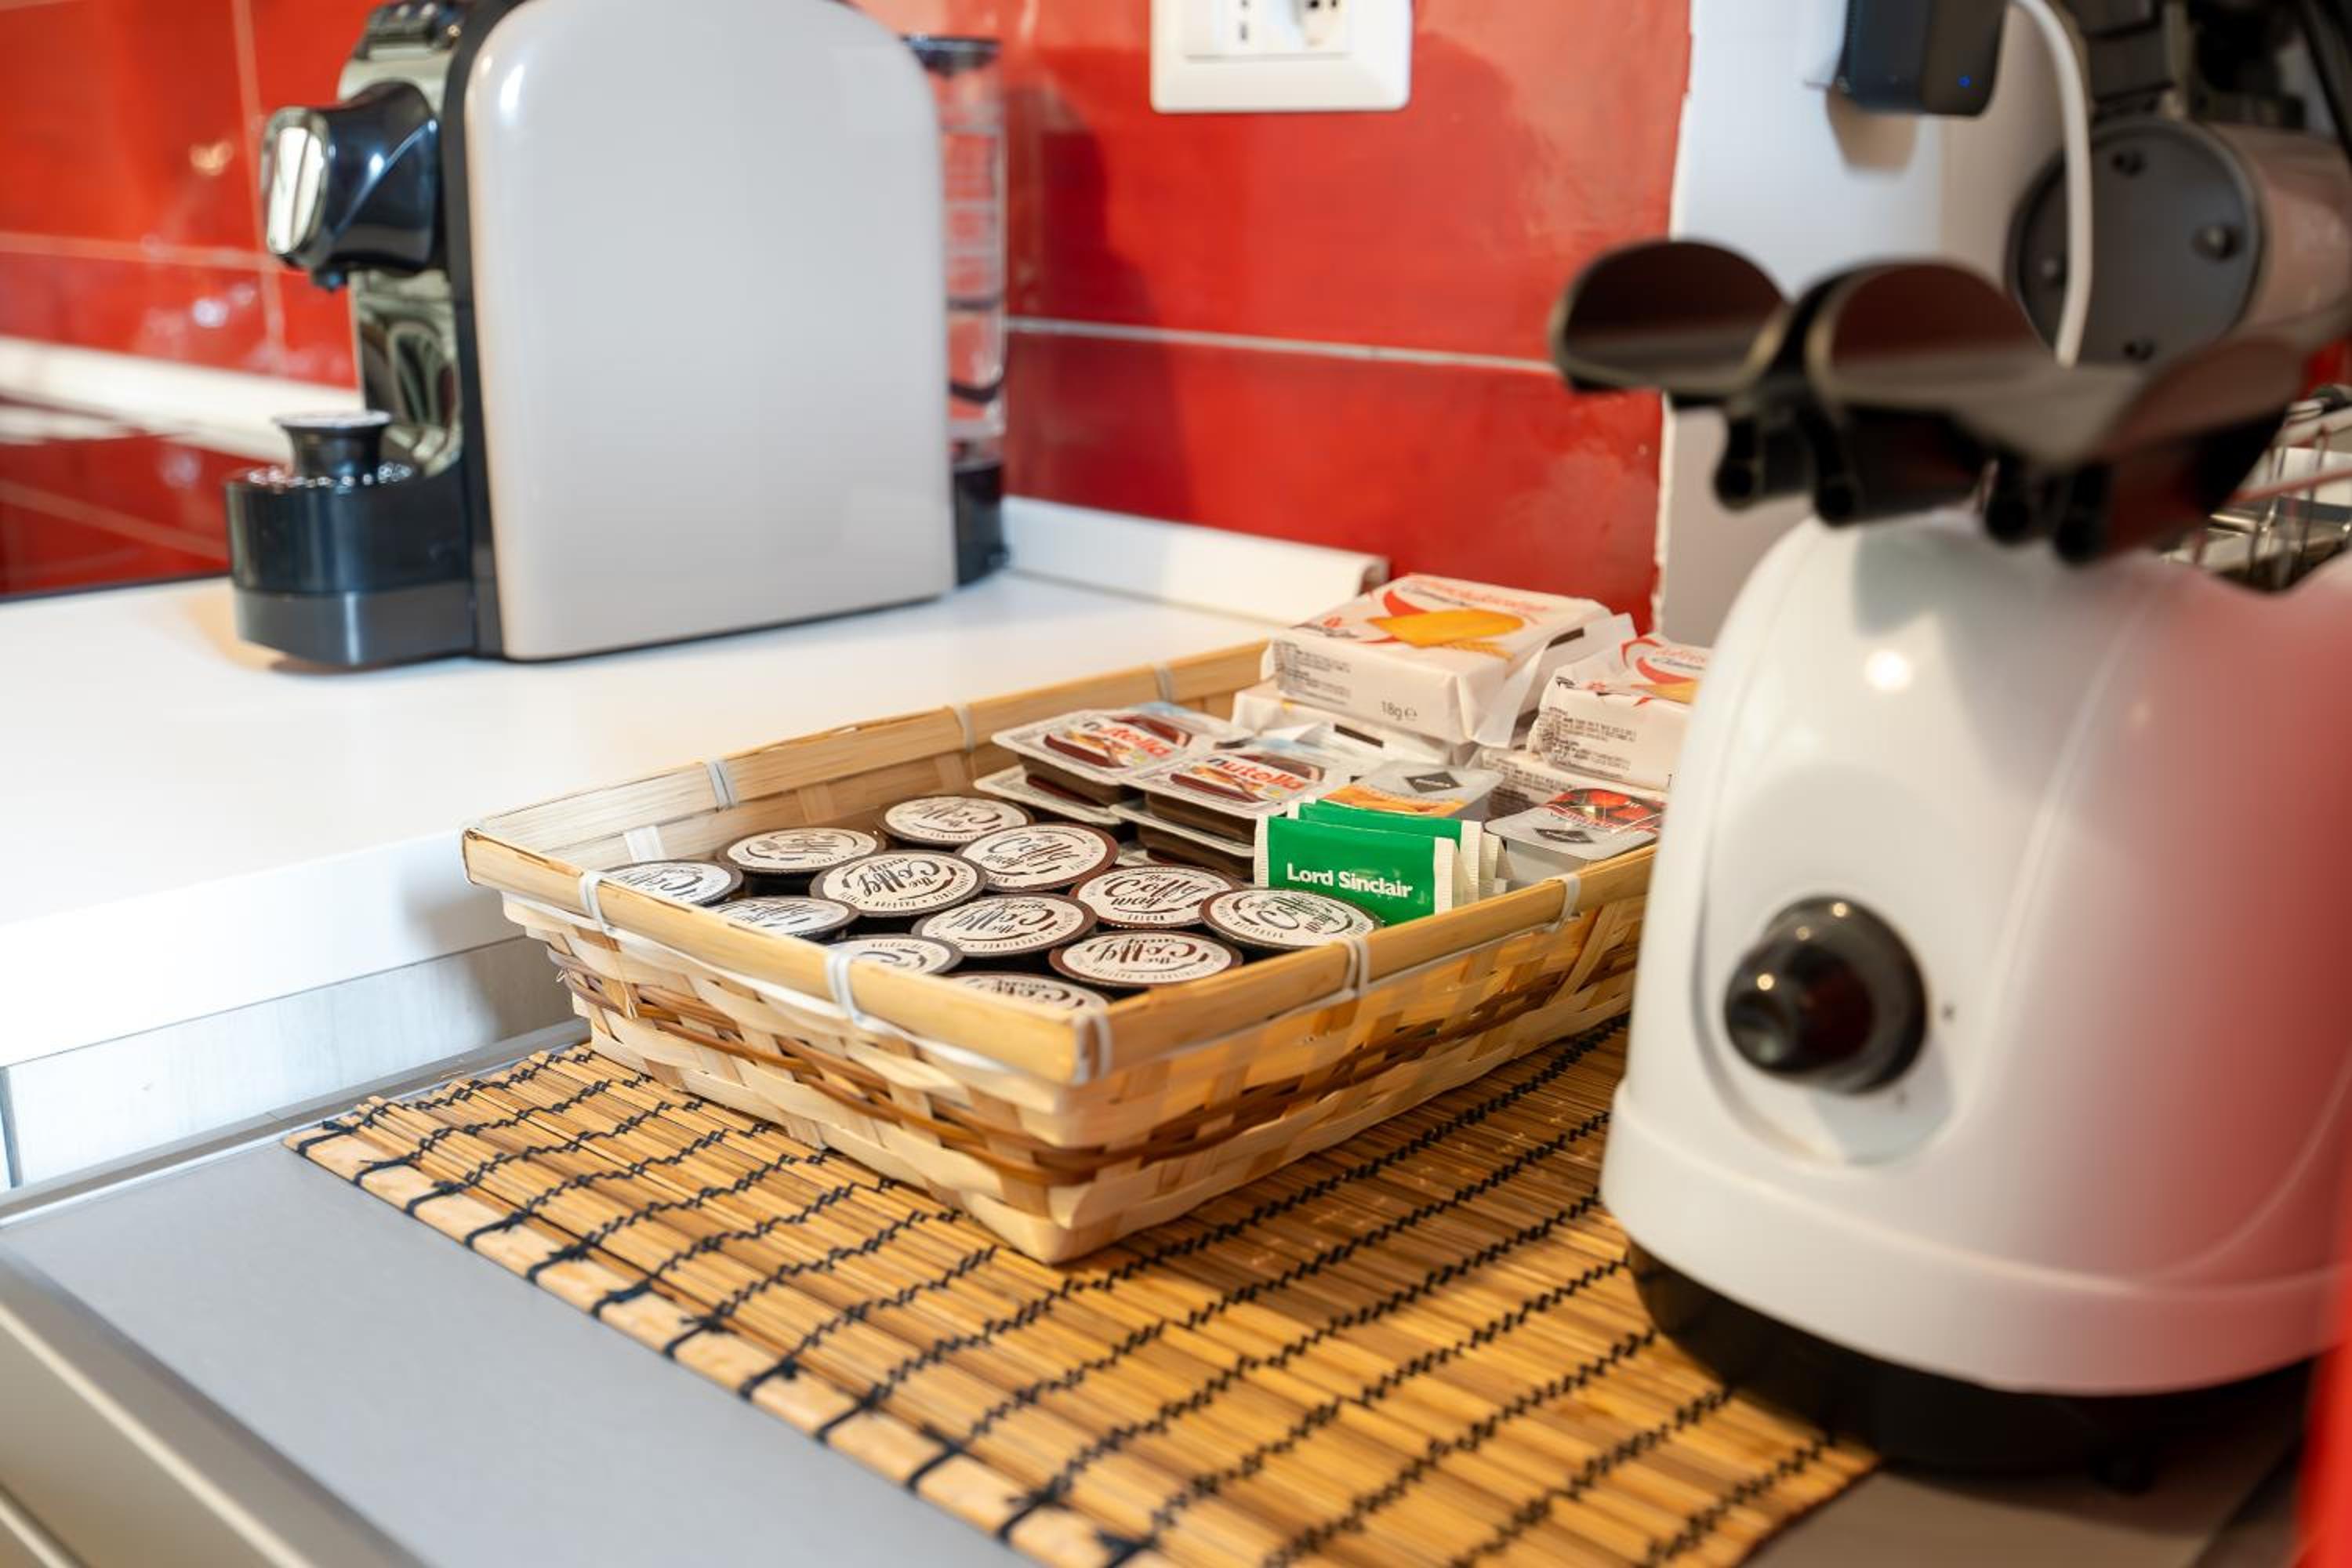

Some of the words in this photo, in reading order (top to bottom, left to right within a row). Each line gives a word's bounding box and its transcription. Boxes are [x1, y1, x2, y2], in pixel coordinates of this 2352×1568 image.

[1082, 720, 1172, 758] nutella
[1207, 757, 1306, 791] nutella
[1287, 862, 1334, 887] Lord
[1338, 870, 1414, 898] Sinclair
[1110, 896, 1163, 909] way
